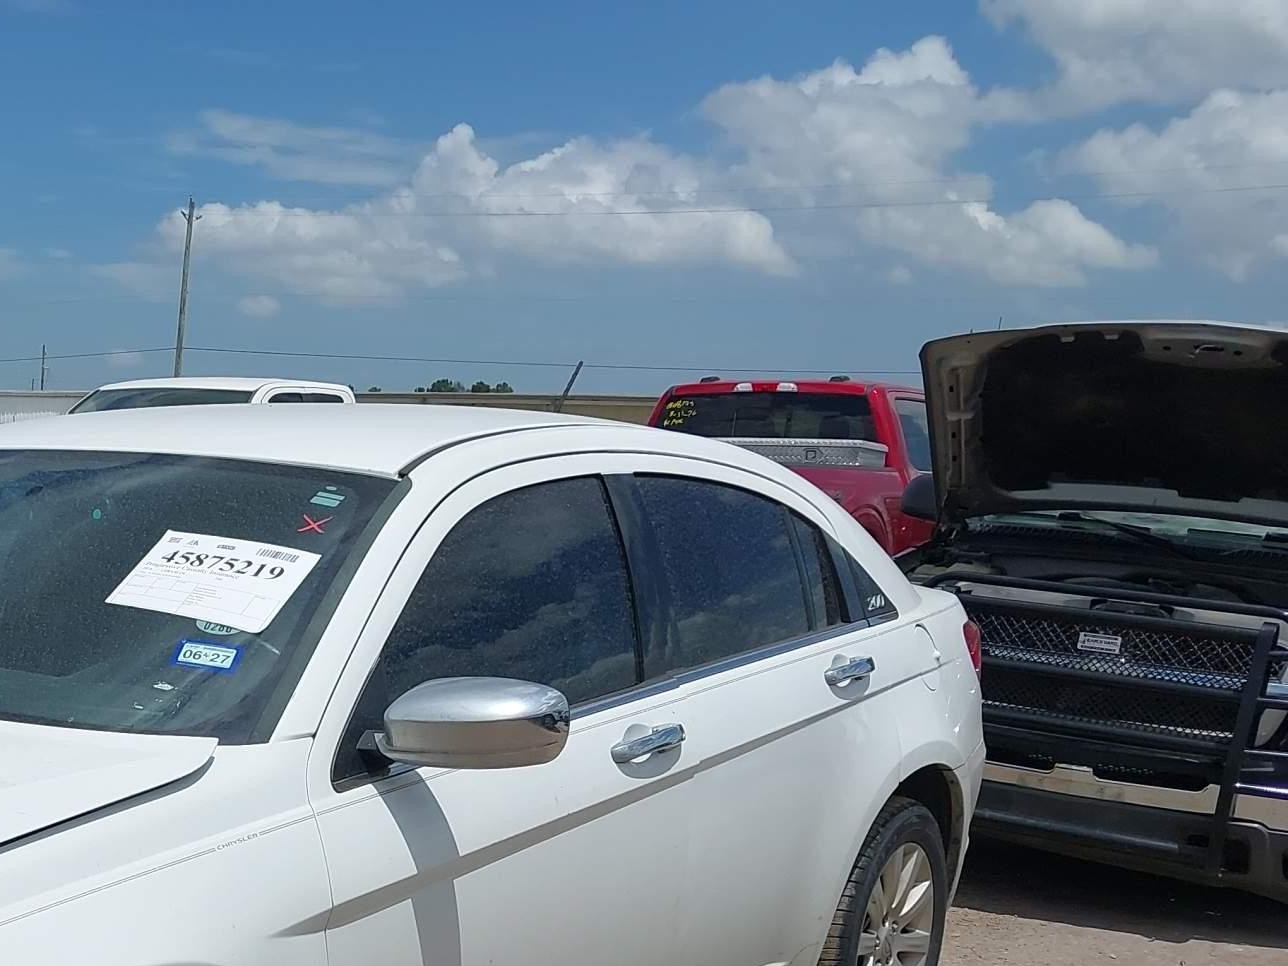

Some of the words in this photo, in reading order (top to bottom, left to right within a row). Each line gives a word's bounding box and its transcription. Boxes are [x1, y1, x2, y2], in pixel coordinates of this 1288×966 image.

[160, 549, 285, 580] 45875219
[182, 649, 203, 661] 06
[209, 651, 231, 665] 27
[216, 832, 258, 851] CHRYSLER
